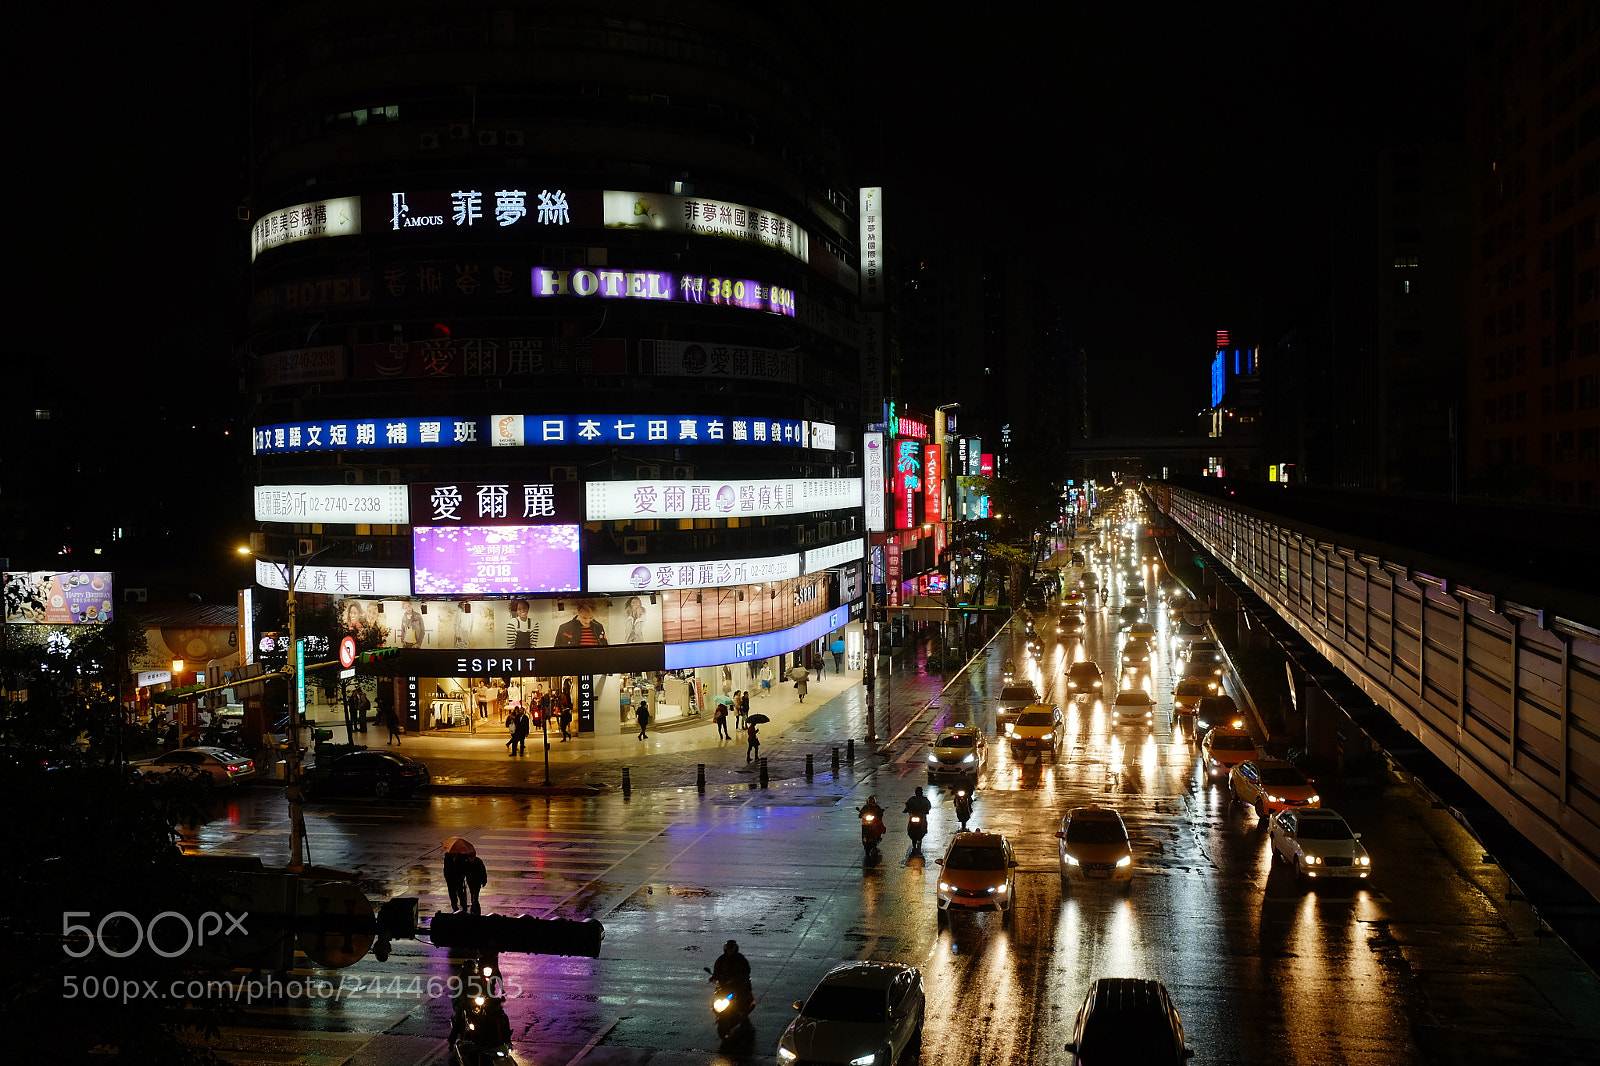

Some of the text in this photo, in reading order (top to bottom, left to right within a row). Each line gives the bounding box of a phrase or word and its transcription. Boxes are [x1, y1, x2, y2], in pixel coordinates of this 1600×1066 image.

[389, 191, 443, 230] FAMOUS
[451, 189, 570, 227] 菲夢絲
[299, 225, 327, 237] BEAUTY
[685, 222, 724, 234] FAMOUS
[286, 276, 370, 308] HOTEL
[540, 269, 669, 300] HOTEL
[680, 276, 703, 291] 休息
[707, 278, 745, 300] 380
[771, 286, 791, 308] 880
[420, 338, 546, 376] 愛爾麗
[711, 347, 791, 378] 愛爾麗診所
[542, 419, 800, 443] 日本七田真右腦開發中心
[926, 450, 937, 495] TASTY
[309, 497, 381, 512] 02-2740-2338
[430, 483, 555, 521] 愛爾麗
[634, 485, 712, 514] 愛爾麗
[739, 483, 794, 513] 醫療集團
[477, 565, 511, 577] 2018
[656, 561, 748, 587] 愛爾麗診所
[457, 657, 536, 672] ESPRIT
[735, 640, 760, 658] NET
[409, 676, 417, 720] ESPRIT
[581, 675, 590, 721] ESPRIT
